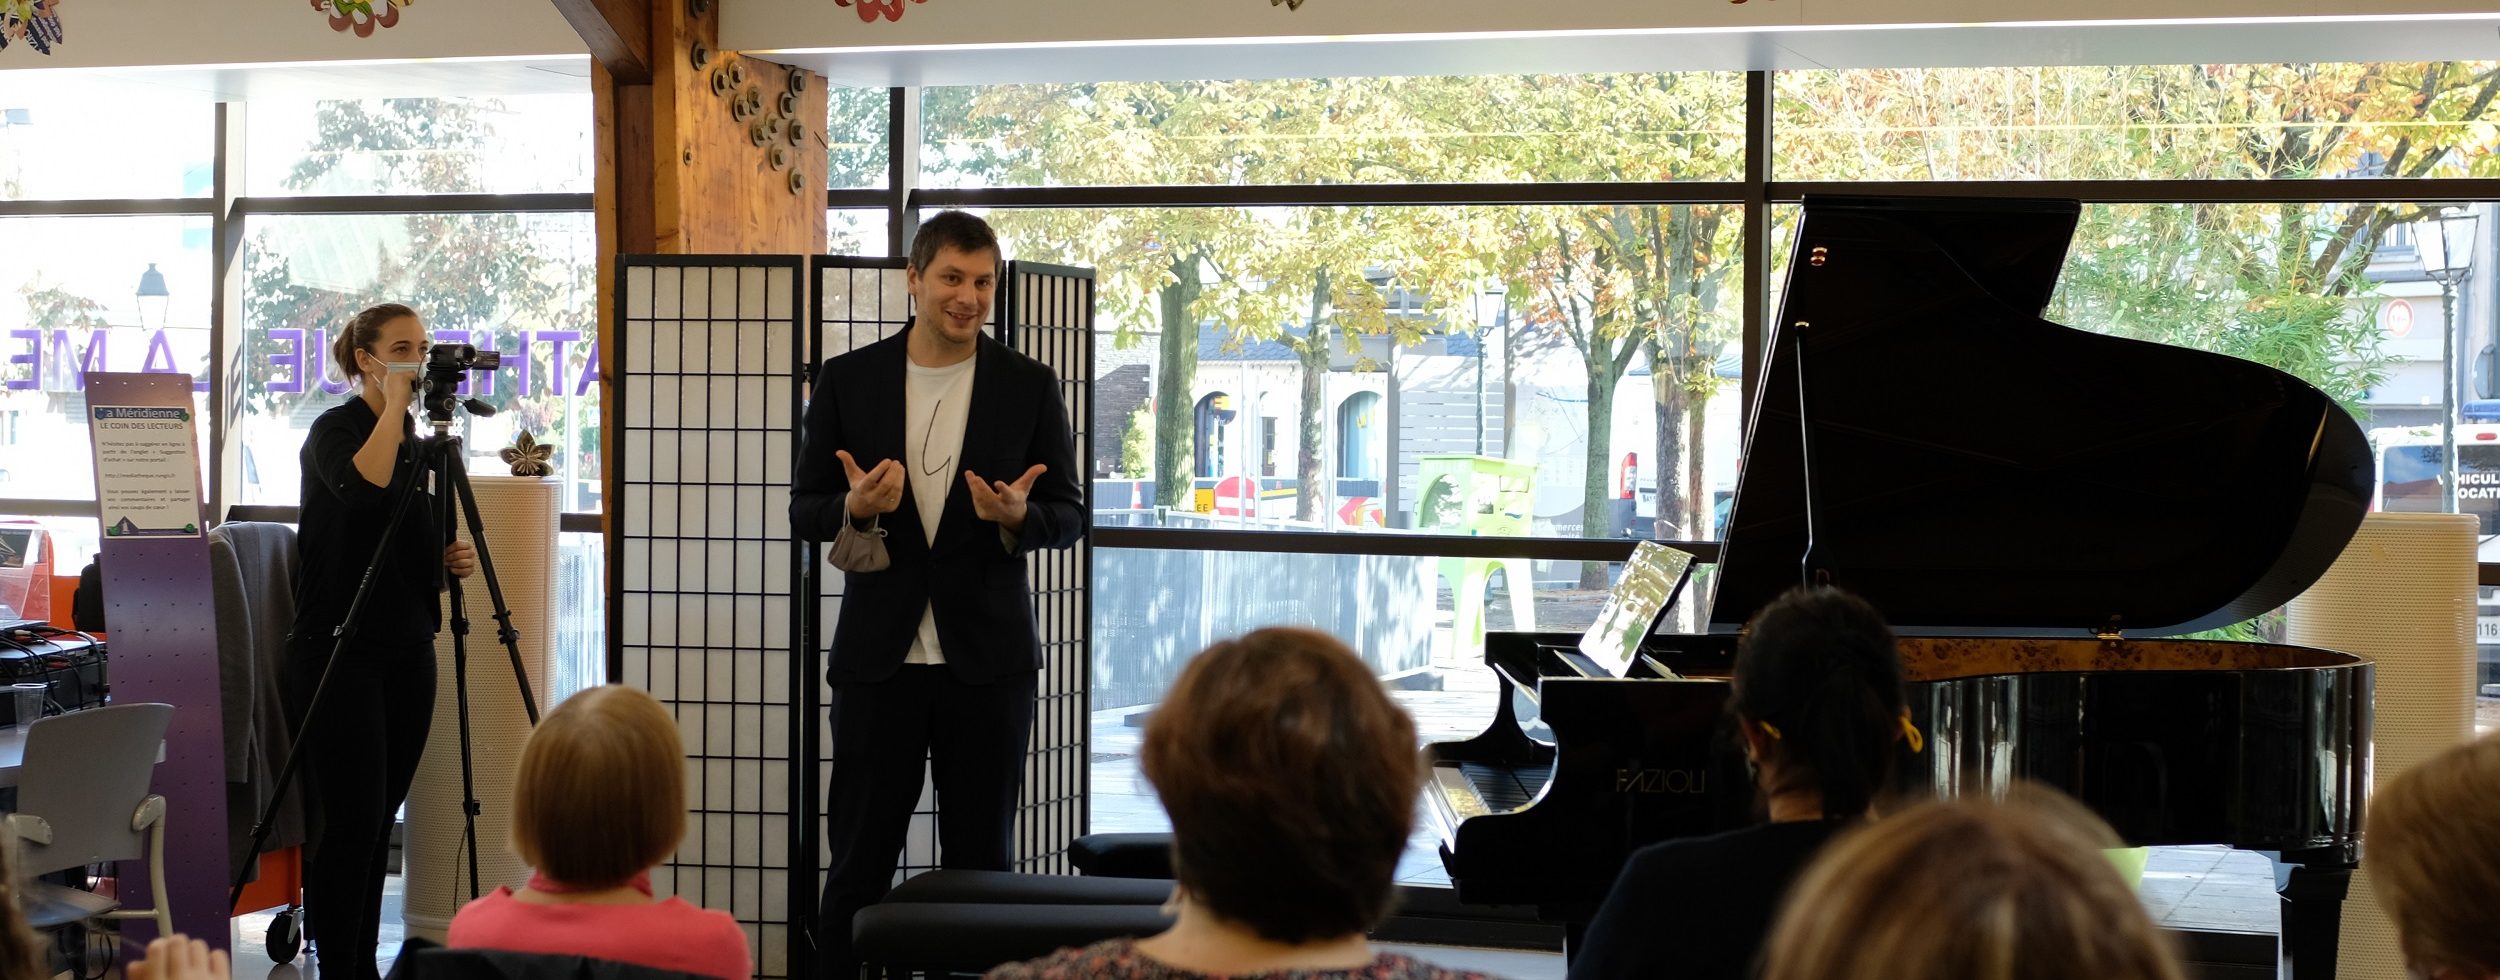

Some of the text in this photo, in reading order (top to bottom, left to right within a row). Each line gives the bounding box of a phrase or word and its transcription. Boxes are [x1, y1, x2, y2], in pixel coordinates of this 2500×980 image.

[116, 408, 180, 418] Méridienne
[131, 422, 146, 430] DES
[147, 422, 184, 430] LECTEURS
[1616, 768, 1705, 793] FAZIOLI
